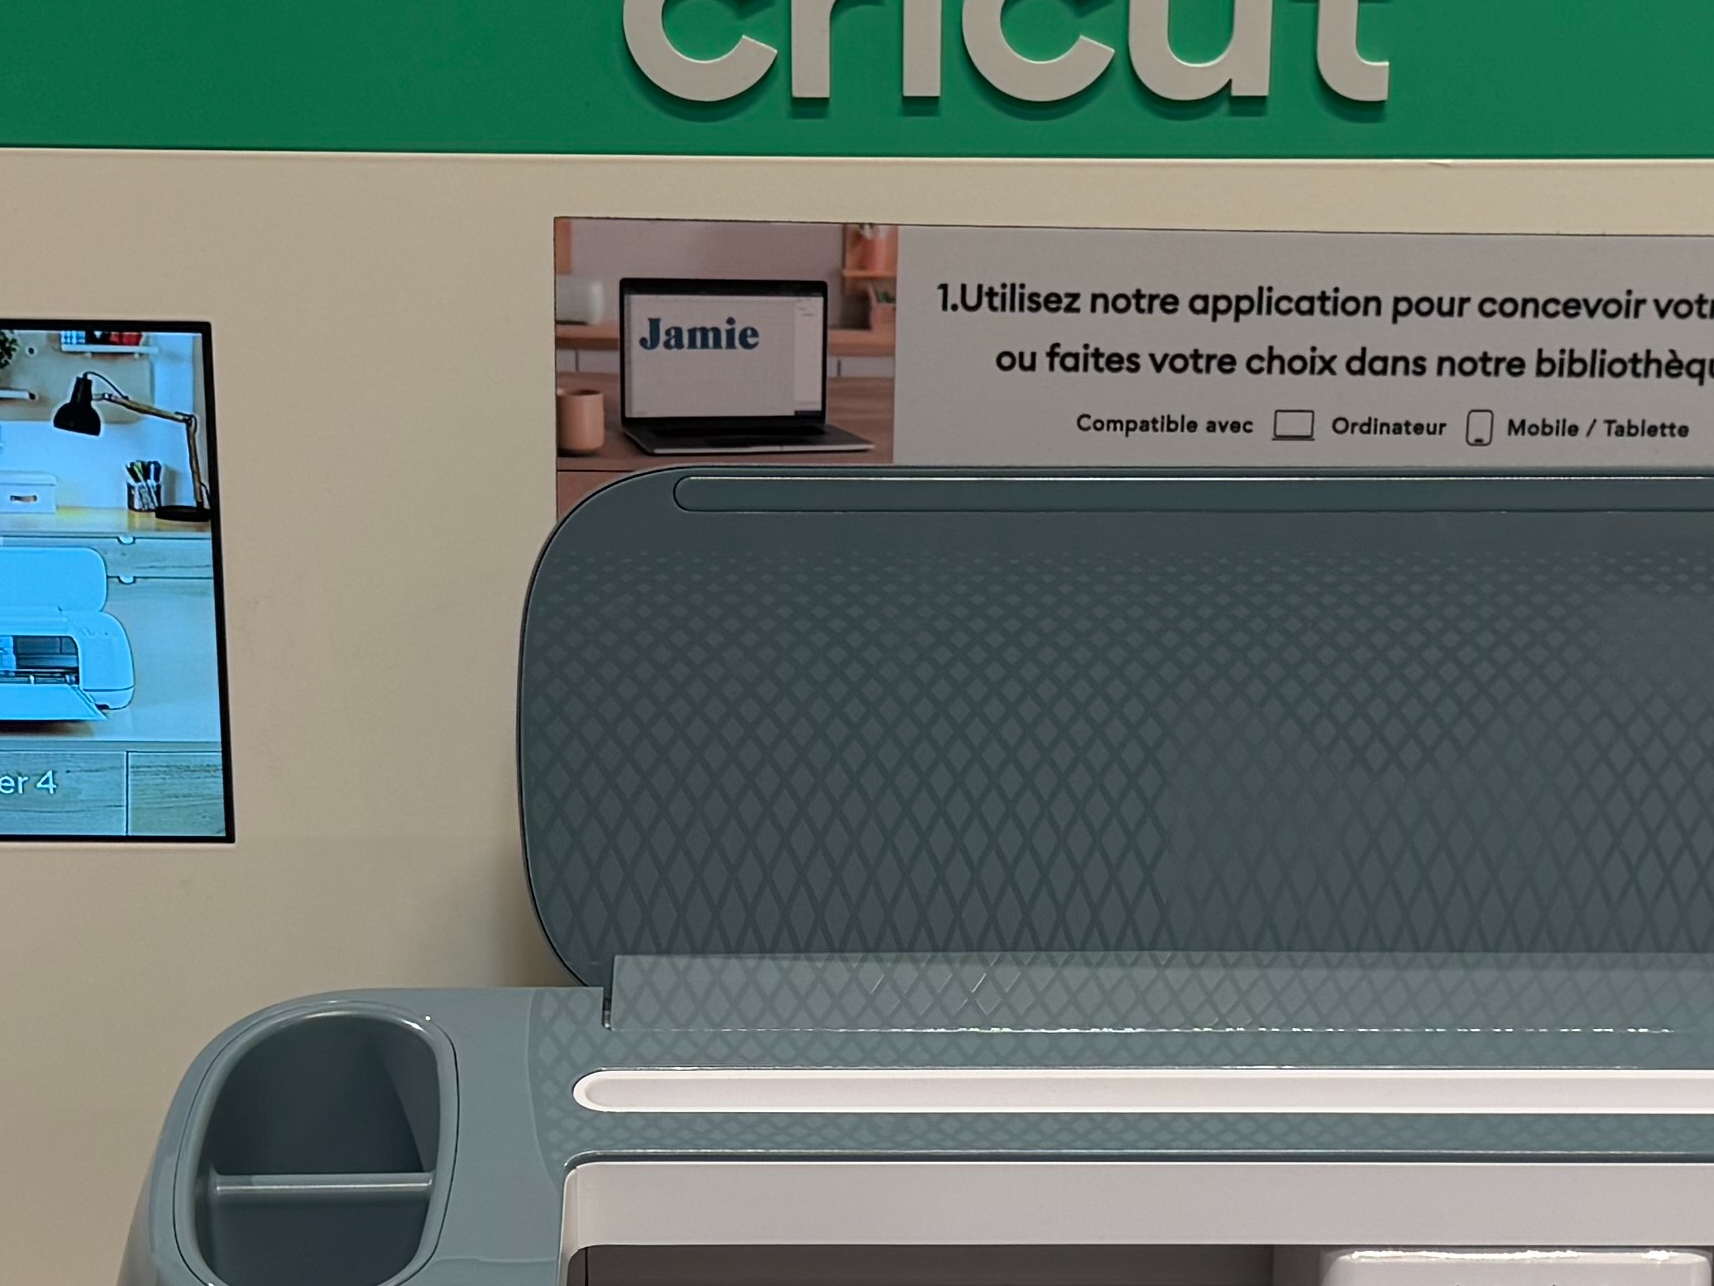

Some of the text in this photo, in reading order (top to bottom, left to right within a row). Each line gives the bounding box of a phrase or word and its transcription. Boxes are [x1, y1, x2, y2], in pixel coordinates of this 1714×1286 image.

[937, 282, 1081, 314] 1.Utilisez
[1090, 288, 1180, 315] notre
[1188, 285, 1382, 323] application
[1391, 296, 1472, 325] pour
[1477, 288, 1648, 320] concevoir
[639, 316, 760, 351] Jamie
[995, 350, 1037, 373] ou
[1045, 342, 1141, 374] faites
[1148, 348, 1237, 375] votre
[1245, 345, 1338, 376] choix
[1345, 346, 1427, 377] dans
[1436, 350, 1526, 378] notre
[1076, 413, 1690, 438] Compatible avec Ordinateur Mobile / Tablette
[36, 770, 58, 795] 4
